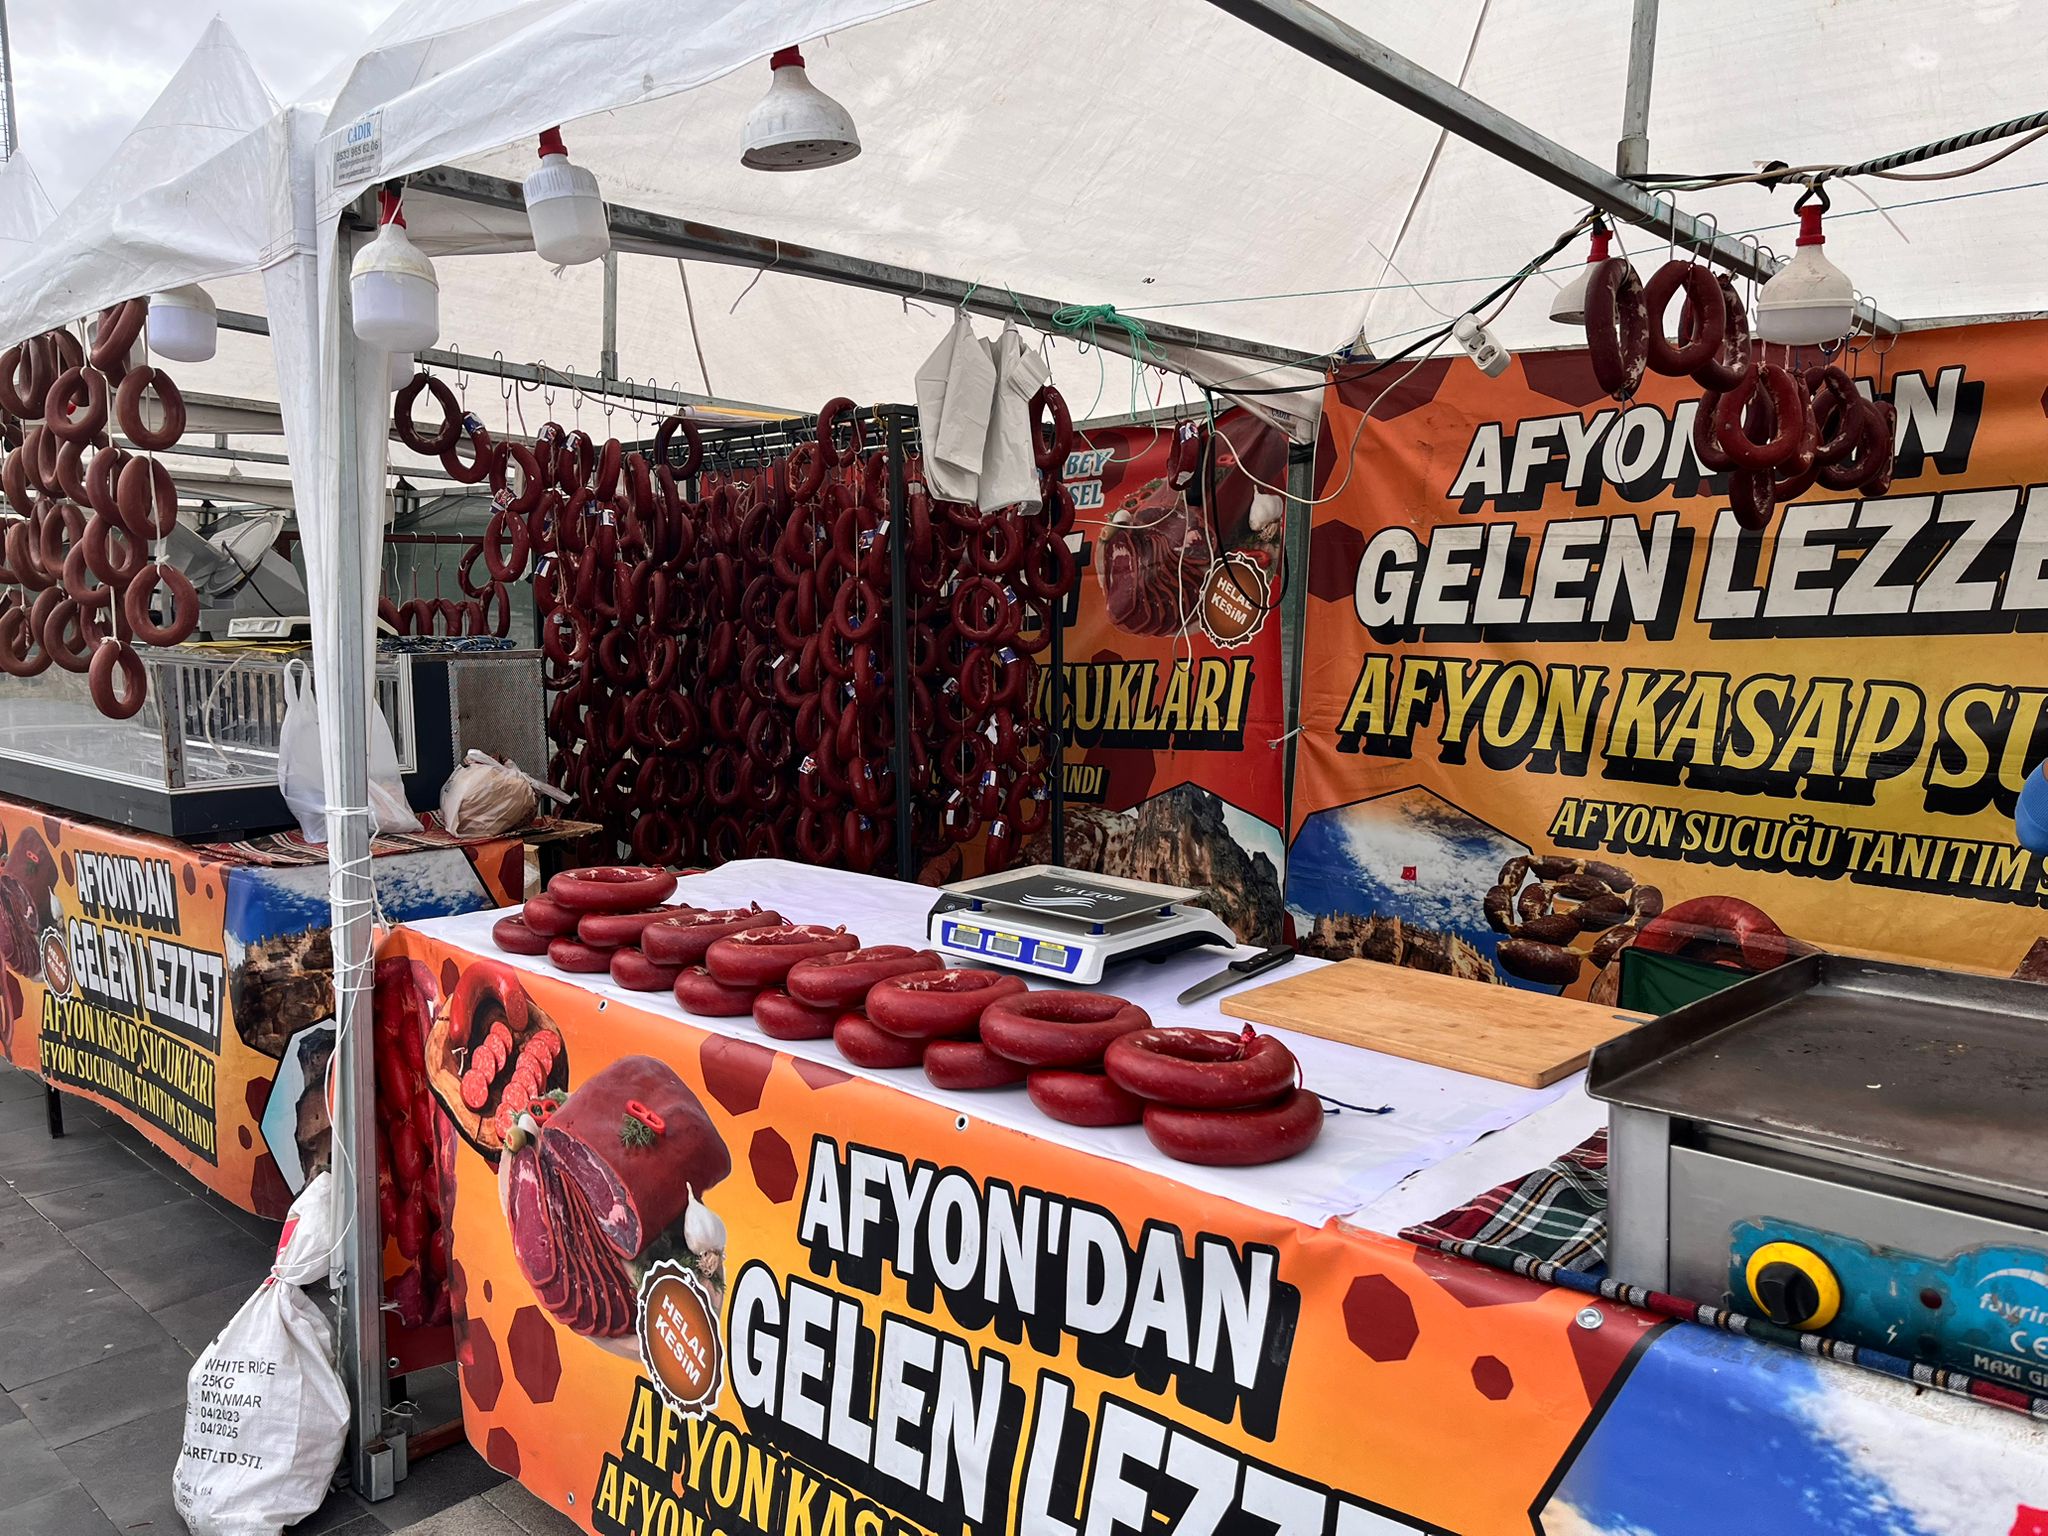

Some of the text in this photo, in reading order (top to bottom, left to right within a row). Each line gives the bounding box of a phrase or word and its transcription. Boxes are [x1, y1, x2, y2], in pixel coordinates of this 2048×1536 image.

[1066, 451, 1111, 476] BEY
[1359, 512, 1679, 627] GELEN
[1342, 656, 1605, 757] AFYON
[1606, 671, 1921, 780] KASAP
[75, 853, 174, 919] AFYON'DAN
[1552, 801, 1677, 848] AFYON
[1680, 812, 1842, 867] SUCUĞU
[1846, 831, 2033, 891] TANITIM
[70, 918, 224, 1038] GELEN LEZZET
[43, 993, 215, 1110] AFYON KASAP SUCUKLARI
[39, 1038, 216, 1155] AFYON SUCUKLARI TANITIM STANDI
[801, 1139, 1275, 1390] AFYON'DAN
[205, 1357, 277, 1376] WHITE RICE
[661, 1293, 707, 1369] HELAL
[1973, 1353, 2022, 1380] MAXI
[200, 1406, 240, 1424] 04/2023
[201, 1390, 262, 1409] MYANMAR
[202, 1374, 236, 1390] 25KG
[731, 1266, 1004, 1524] GELEN
[200, 1422, 239, 1440] 04/2025
[626, 1385, 777, 1533] AFYON
